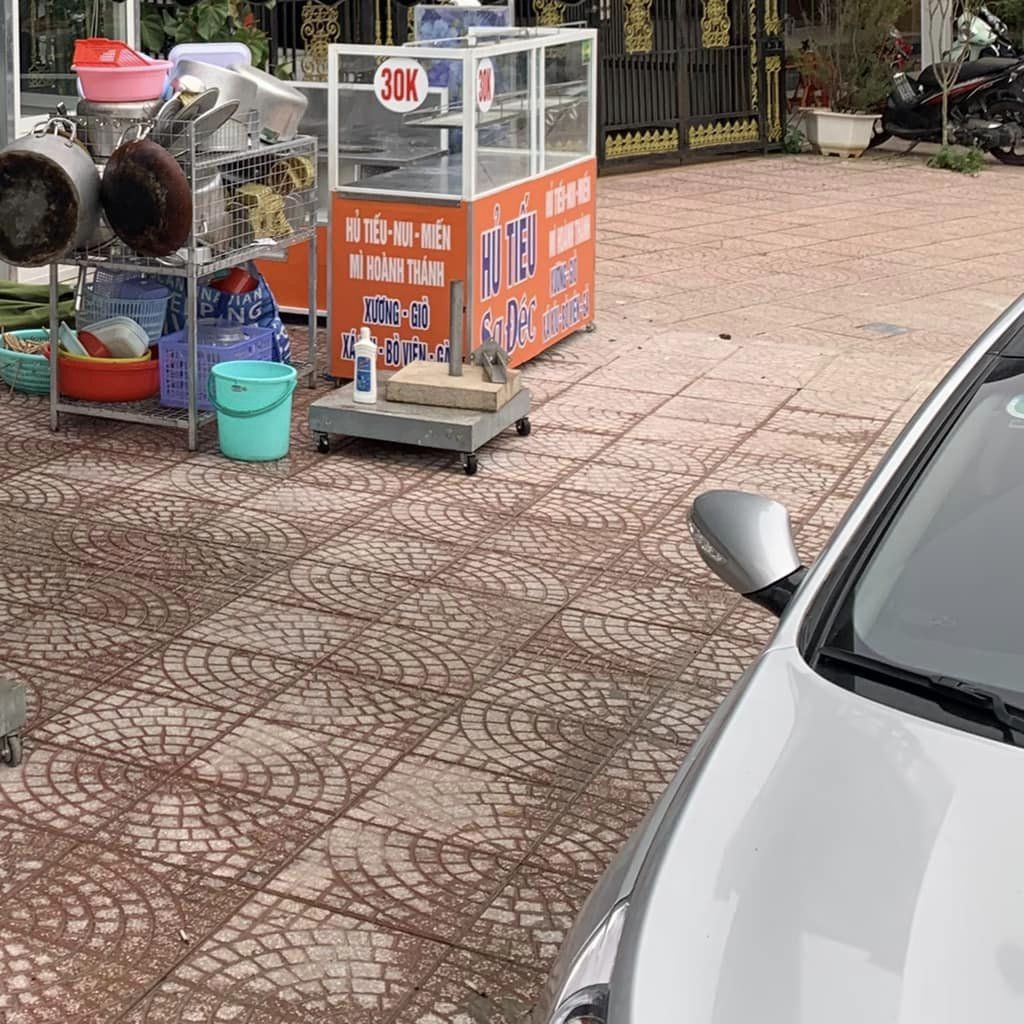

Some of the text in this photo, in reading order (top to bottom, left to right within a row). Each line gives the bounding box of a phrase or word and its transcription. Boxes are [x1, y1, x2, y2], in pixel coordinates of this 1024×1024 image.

[381, 67, 419, 102] 30K
[345, 209, 361, 242] HỦ
[480, 203, 502, 303] HỦ
[506, 191, 538, 290] TIẾU
[367, 252, 405, 284] HOÀNH
[407, 255, 445, 287] THÁNH
[364, 295, 400, 326] XƯƠNG
